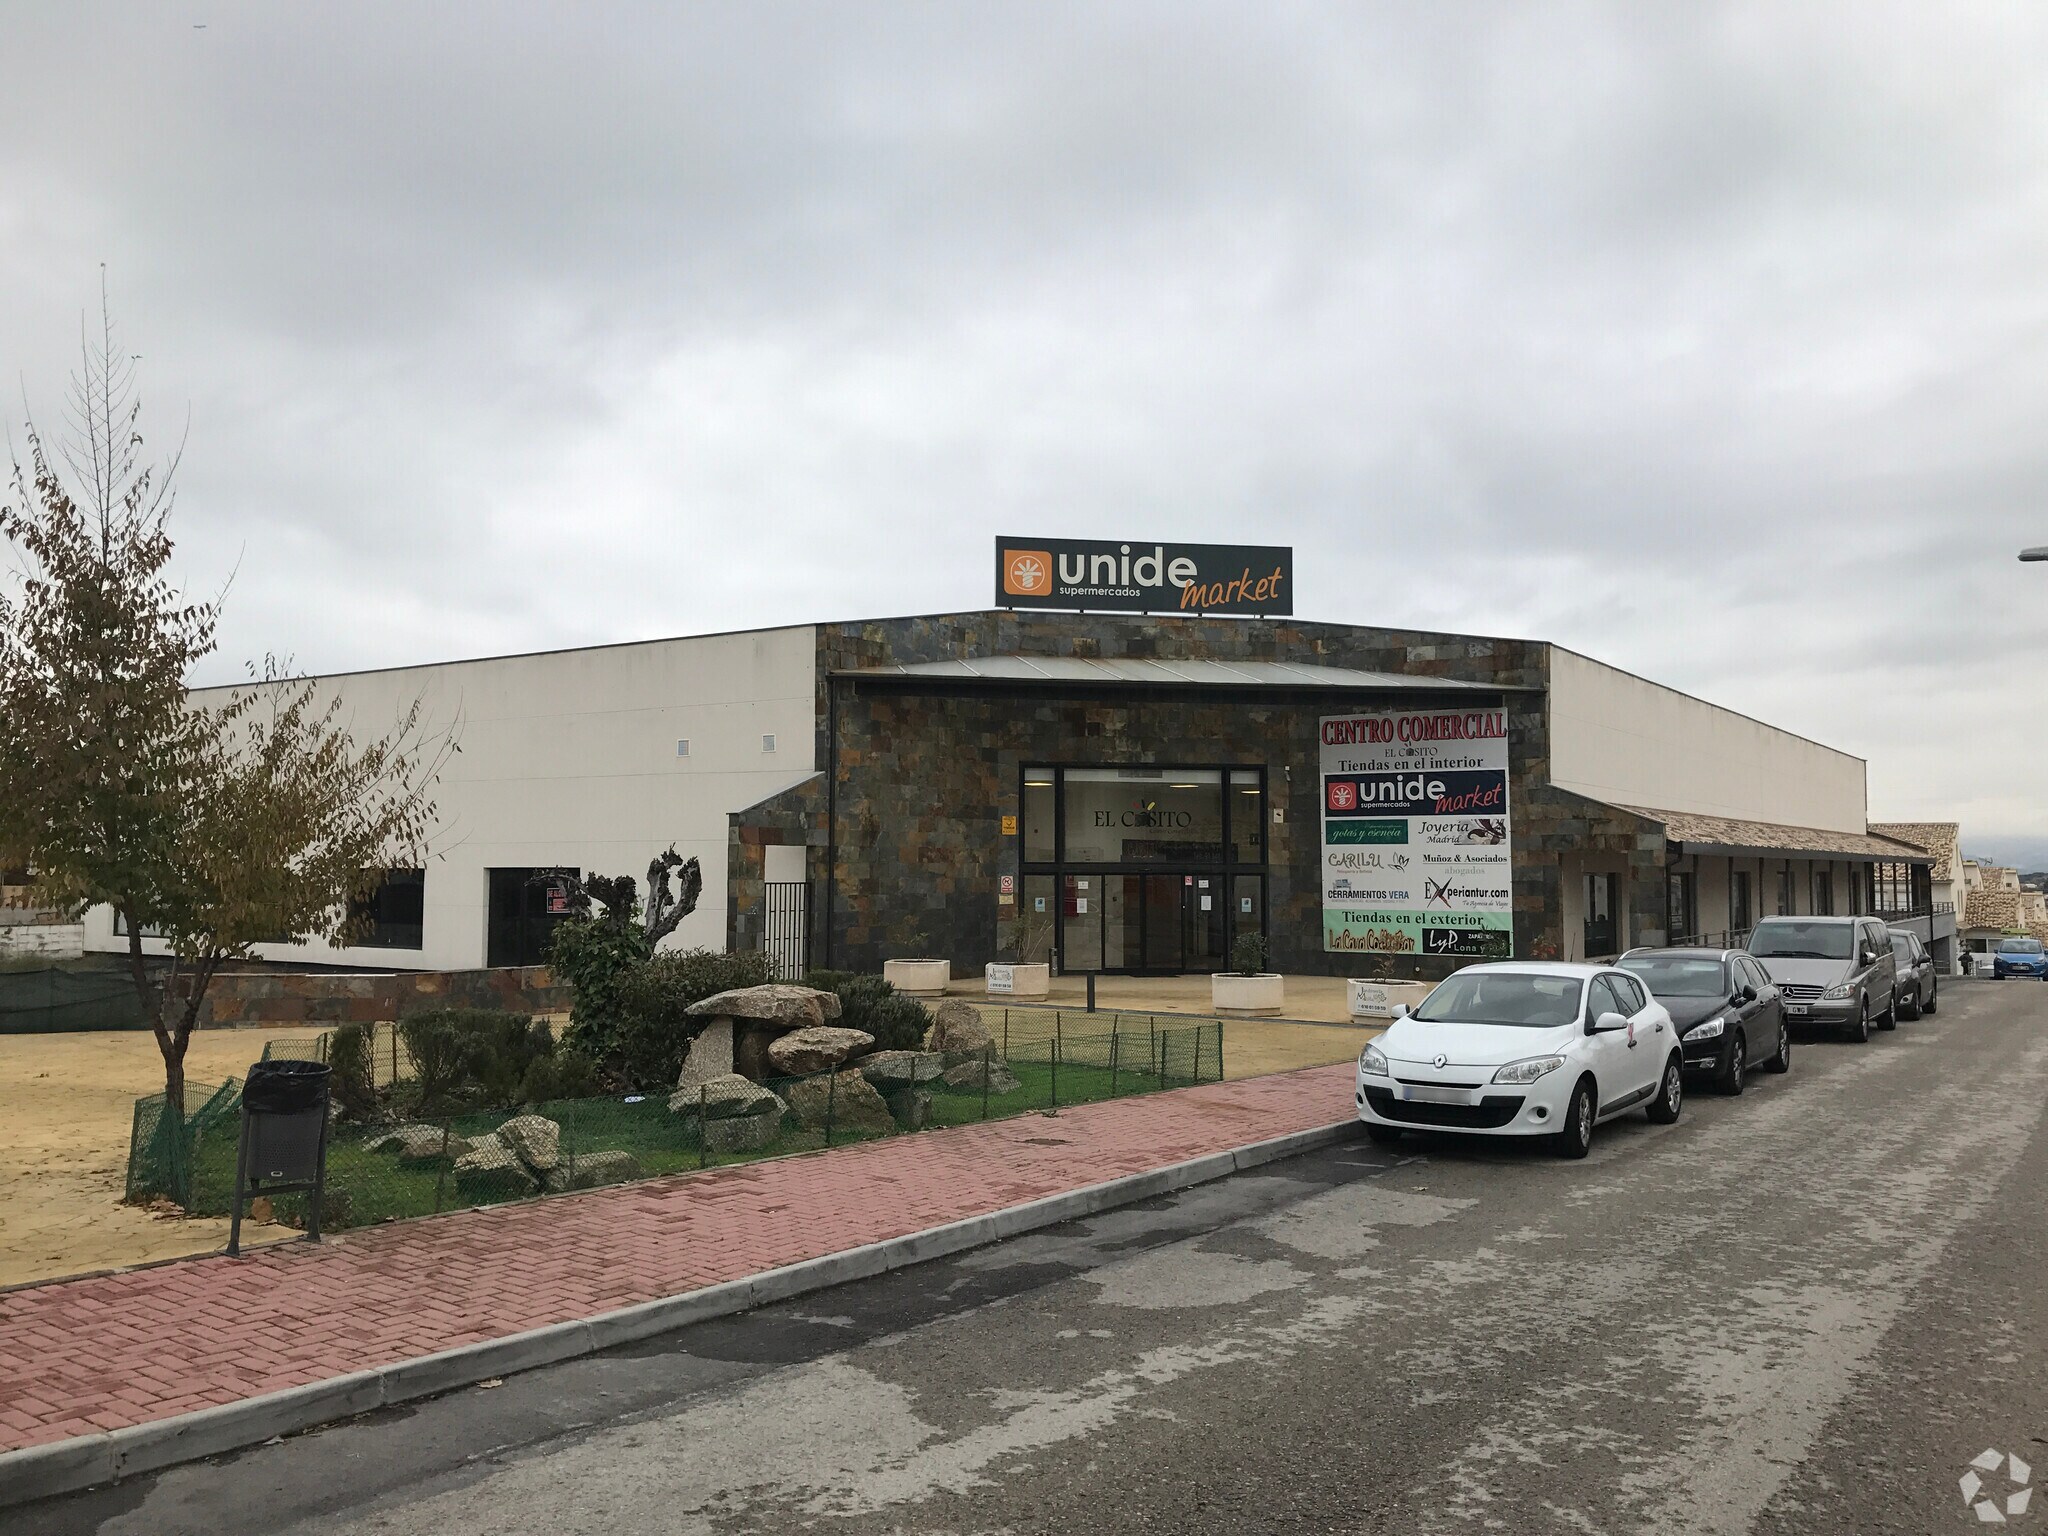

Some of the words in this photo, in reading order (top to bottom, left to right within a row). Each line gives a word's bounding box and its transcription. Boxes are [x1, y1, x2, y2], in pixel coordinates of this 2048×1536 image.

[1058, 544, 1199, 588] unide
[1058, 586, 1141, 597] supermercados
[1180, 566, 1283, 609] market
[1321, 717, 1394, 745] CENTRO
[1397, 712, 1508, 742] COMERCIAL
[1384, 748, 1396, 757] EL
[1338, 759, 1390, 772] Tiendas
[1394, 760, 1409, 770] en
[1414, 758, 1425, 769] el
[1430, 756, 1484, 769] interior
[1359, 774, 1446, 801] unide
[1360, 801, 1410, 809] supermercados
[1434, 783, 1502, 814] market
[1094, 810, 1116, 827] EL
[1426, 835, 1462, 844] Madrid
[1328, 852, 1385, 869] CARILU
[1423, 854, 1452, 862] Muñoz
[1454, 854, 1462, 862] &
[1465, 854, 1508, 862] Asociados
[1445, 866, 1485, 876] abogados
[1328, 890, 1387, 899] CERRAMIENTOS
[1388, 890, 1409, 899] VERA
[1342, 911, 1392, 924] Tiendas
[1396, 914, 1410, 924] en
[1415, 912, 1426, 924] el
[1430, 913, 1484, 926] exterior
[1329, 929, 1341, 949] La
[1343, 928, 1365, 950] Cava
[1454, 943, 1477, 952] Lona
